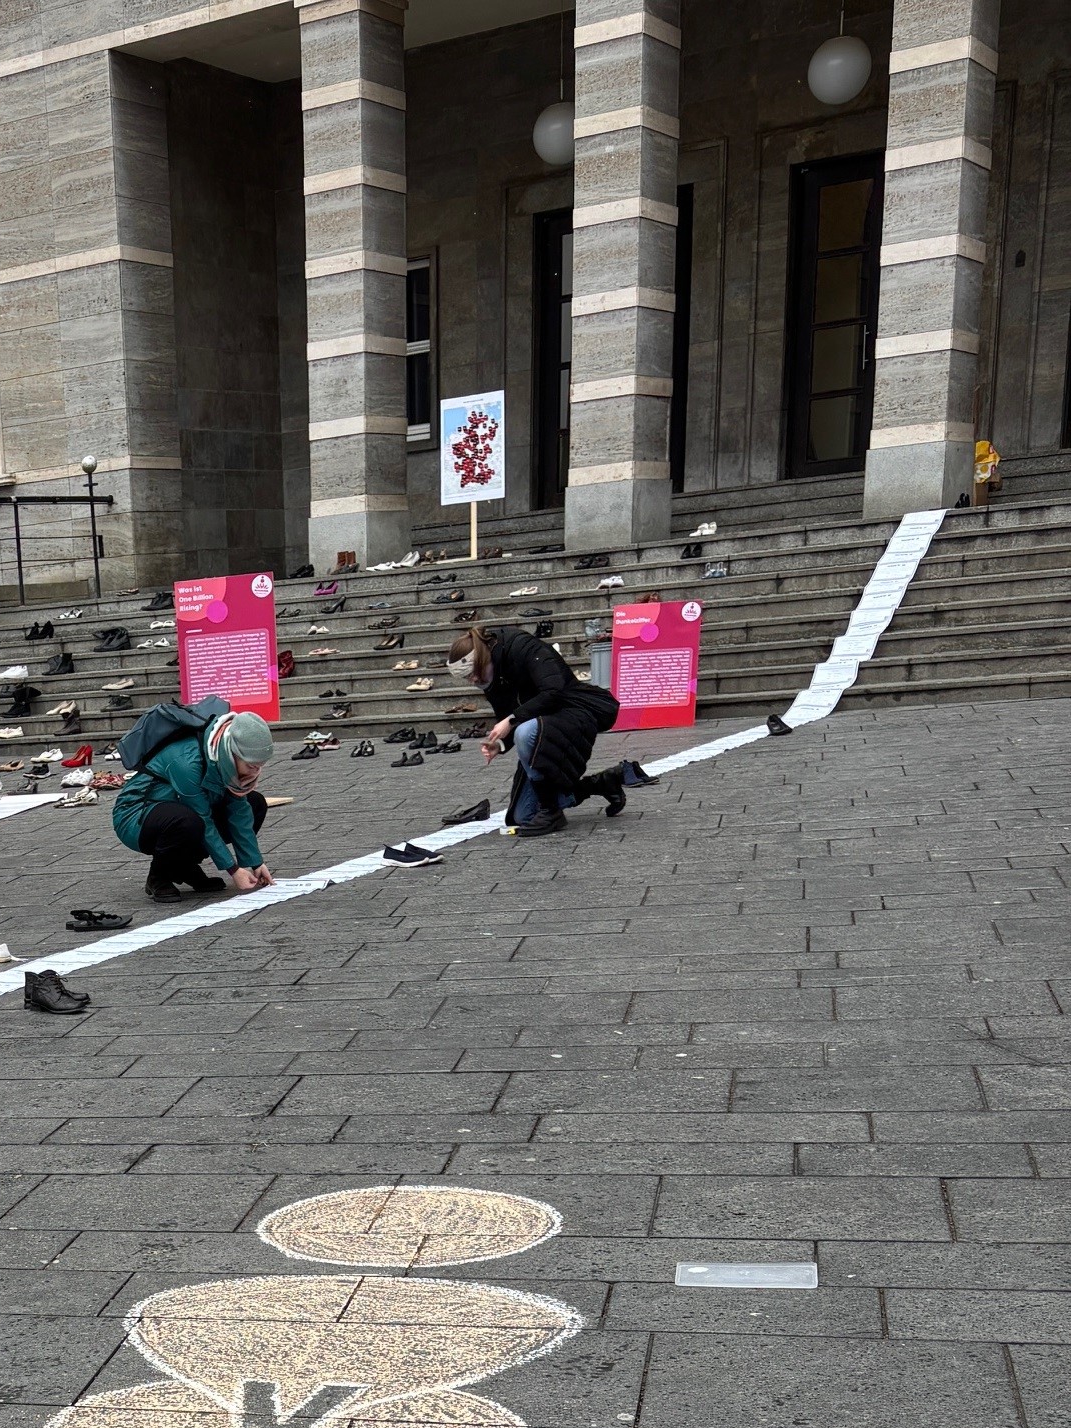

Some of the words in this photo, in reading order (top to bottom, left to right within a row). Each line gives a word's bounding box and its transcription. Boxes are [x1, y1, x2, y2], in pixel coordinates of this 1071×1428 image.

[178, 586, 193, 594] Was
[192, 594, 214, 602] Billion
[179, 603, 203, 612] Rising?
